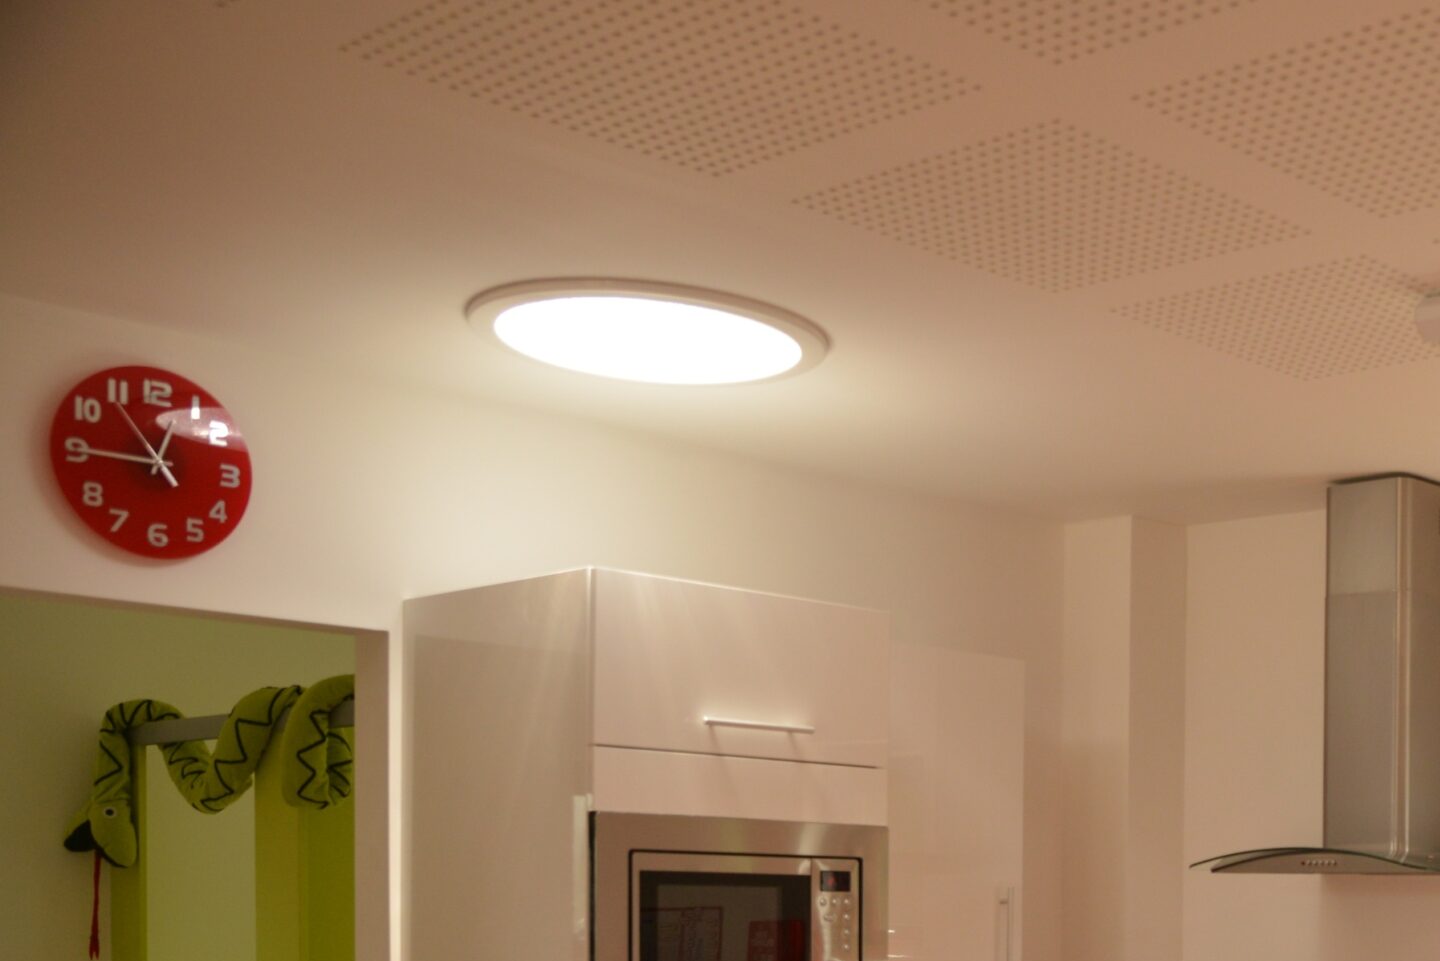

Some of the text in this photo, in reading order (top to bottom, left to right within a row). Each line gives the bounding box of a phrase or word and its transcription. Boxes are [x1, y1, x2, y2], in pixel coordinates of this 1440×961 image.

[107, 378, 128, 405] 11
[143, 378, 173, 408] 12
[74, 395, 102, 423] 10
[191, 395, 200, 420] 1
[209, 420, 228, 447] 2
[64, 437, 91, 463] 9
[220, 464, 240, 488] 3
[82, 480, 103, 507] 8
[108, 508, 129, 533] 7
[208, 500, 228, 523] 4
[147, 524, 169, 547] 6
[185, 517, 204, 542] 5
